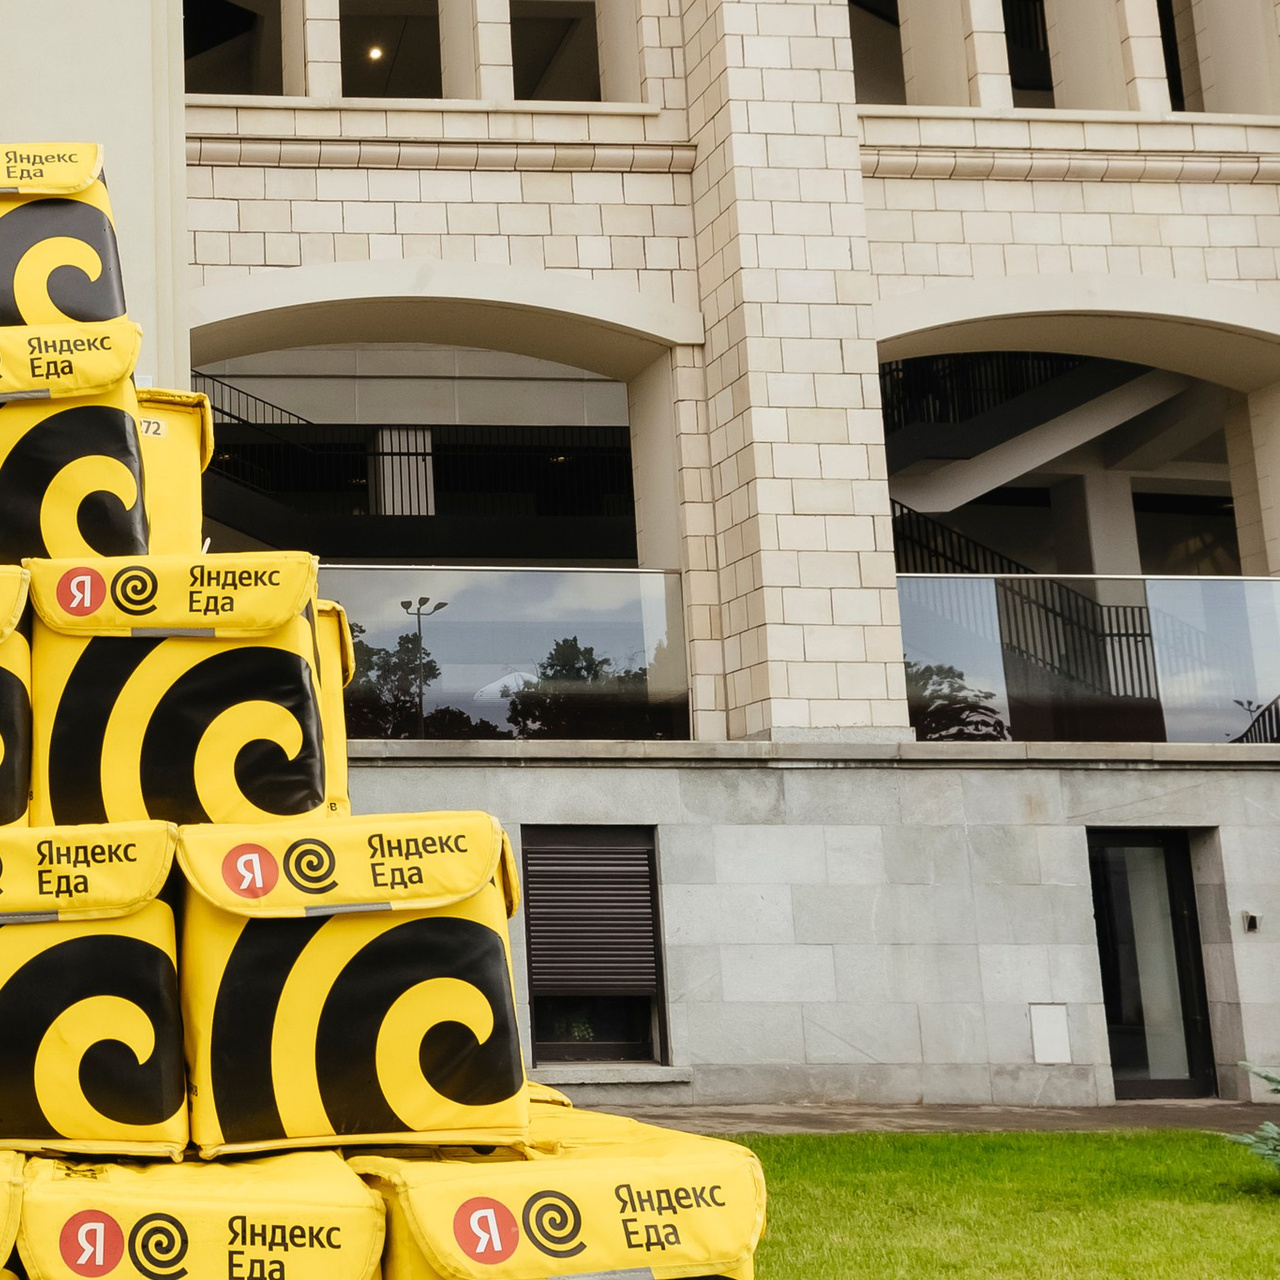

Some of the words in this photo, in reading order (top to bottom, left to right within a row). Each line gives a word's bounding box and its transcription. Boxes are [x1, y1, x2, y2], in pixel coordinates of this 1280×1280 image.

[5, 151, 80, 166] Яндекс
[6, 166, 44, 181] Еда
[27, 336, 112, 355] Яндекс
[29, 357, 74, 380] Еда
[140, 419, 161, 436] 72
[189, 565, 280, 591] Яндекс
[188, 590, 234, 616] Еда
[36, 840, 137, 868] Яндекс
[367, 833, 468, 861] Яндекс
[37, 869, 89, 899] Еда
[370, 862, 424, 890] Еда
[614, 1184, 726, 1216] Яндекс
[228, 1215, 342, 1252] Яндекс
[621, 1218, 681, 1252] Еда
